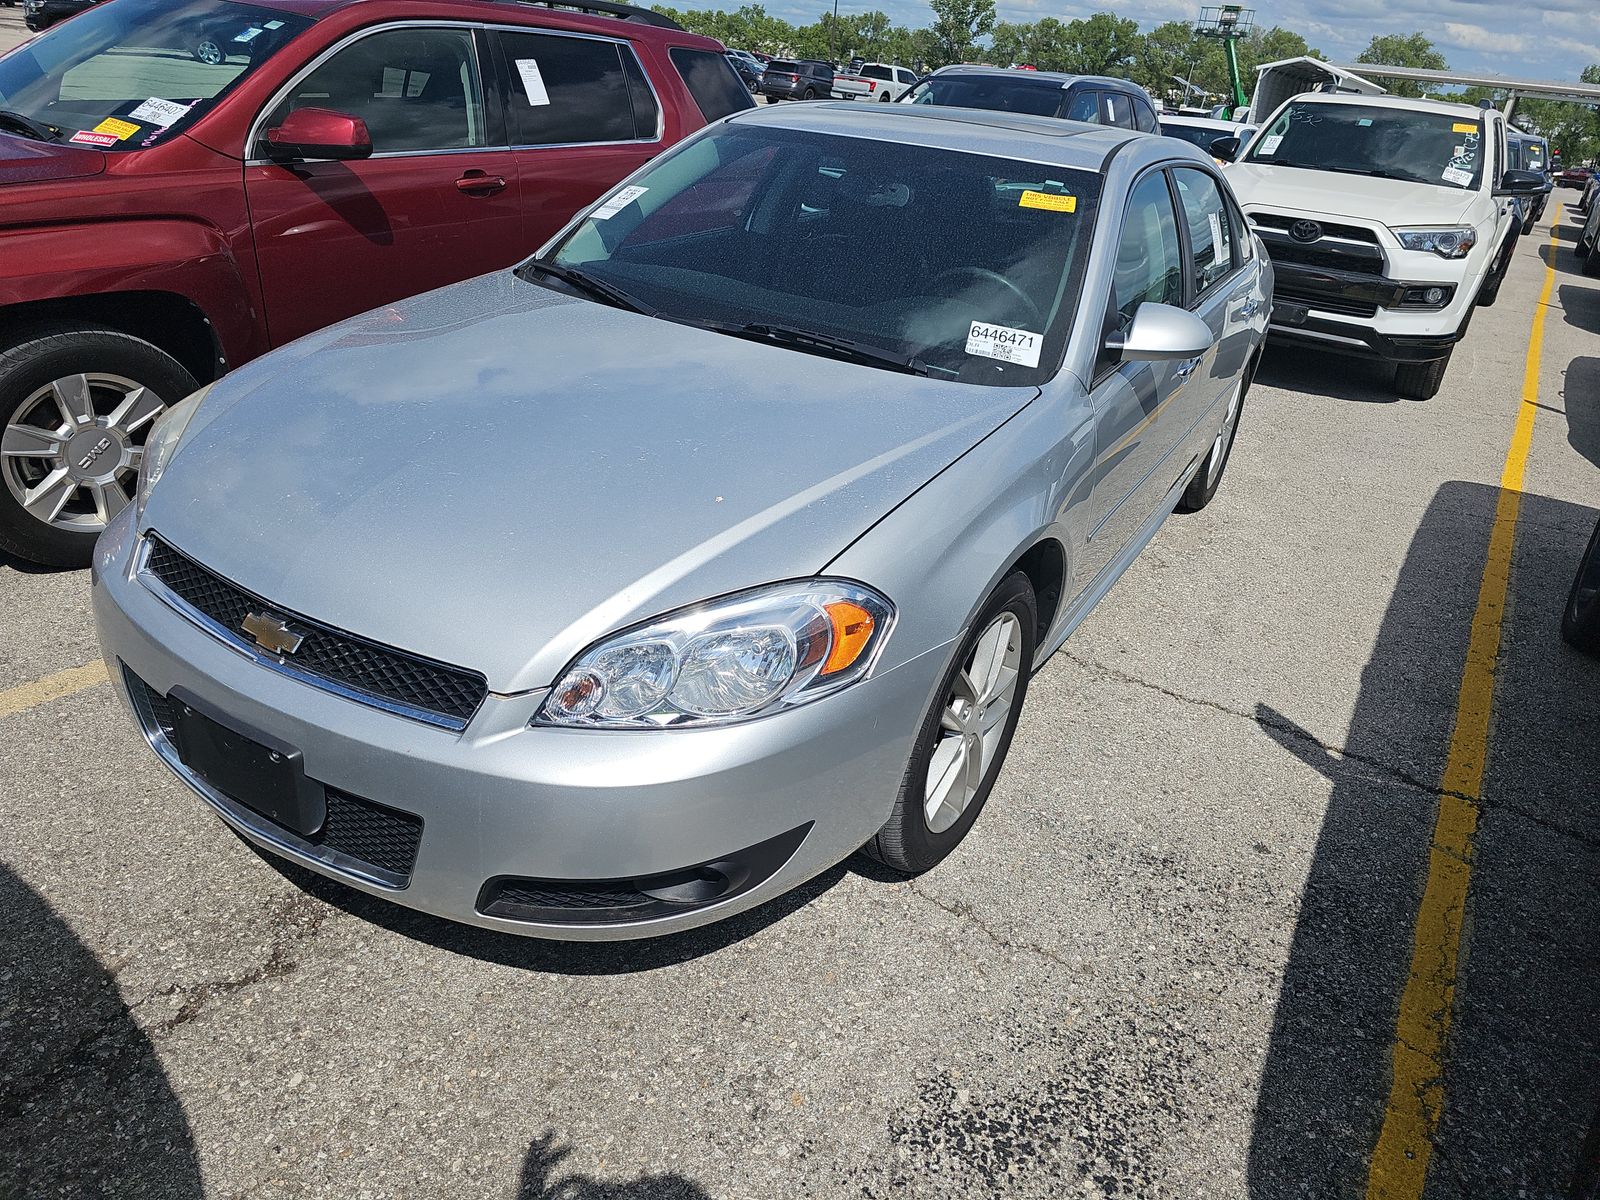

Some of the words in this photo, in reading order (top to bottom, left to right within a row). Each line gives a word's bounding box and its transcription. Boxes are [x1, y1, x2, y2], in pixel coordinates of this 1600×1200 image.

[142, 99, 185, 115] 6446407
[74, 133, 117, 144] WHOLESALE
[971, 325, 1034, 348] 6446471
[78, 437, 111, 469] GMC
